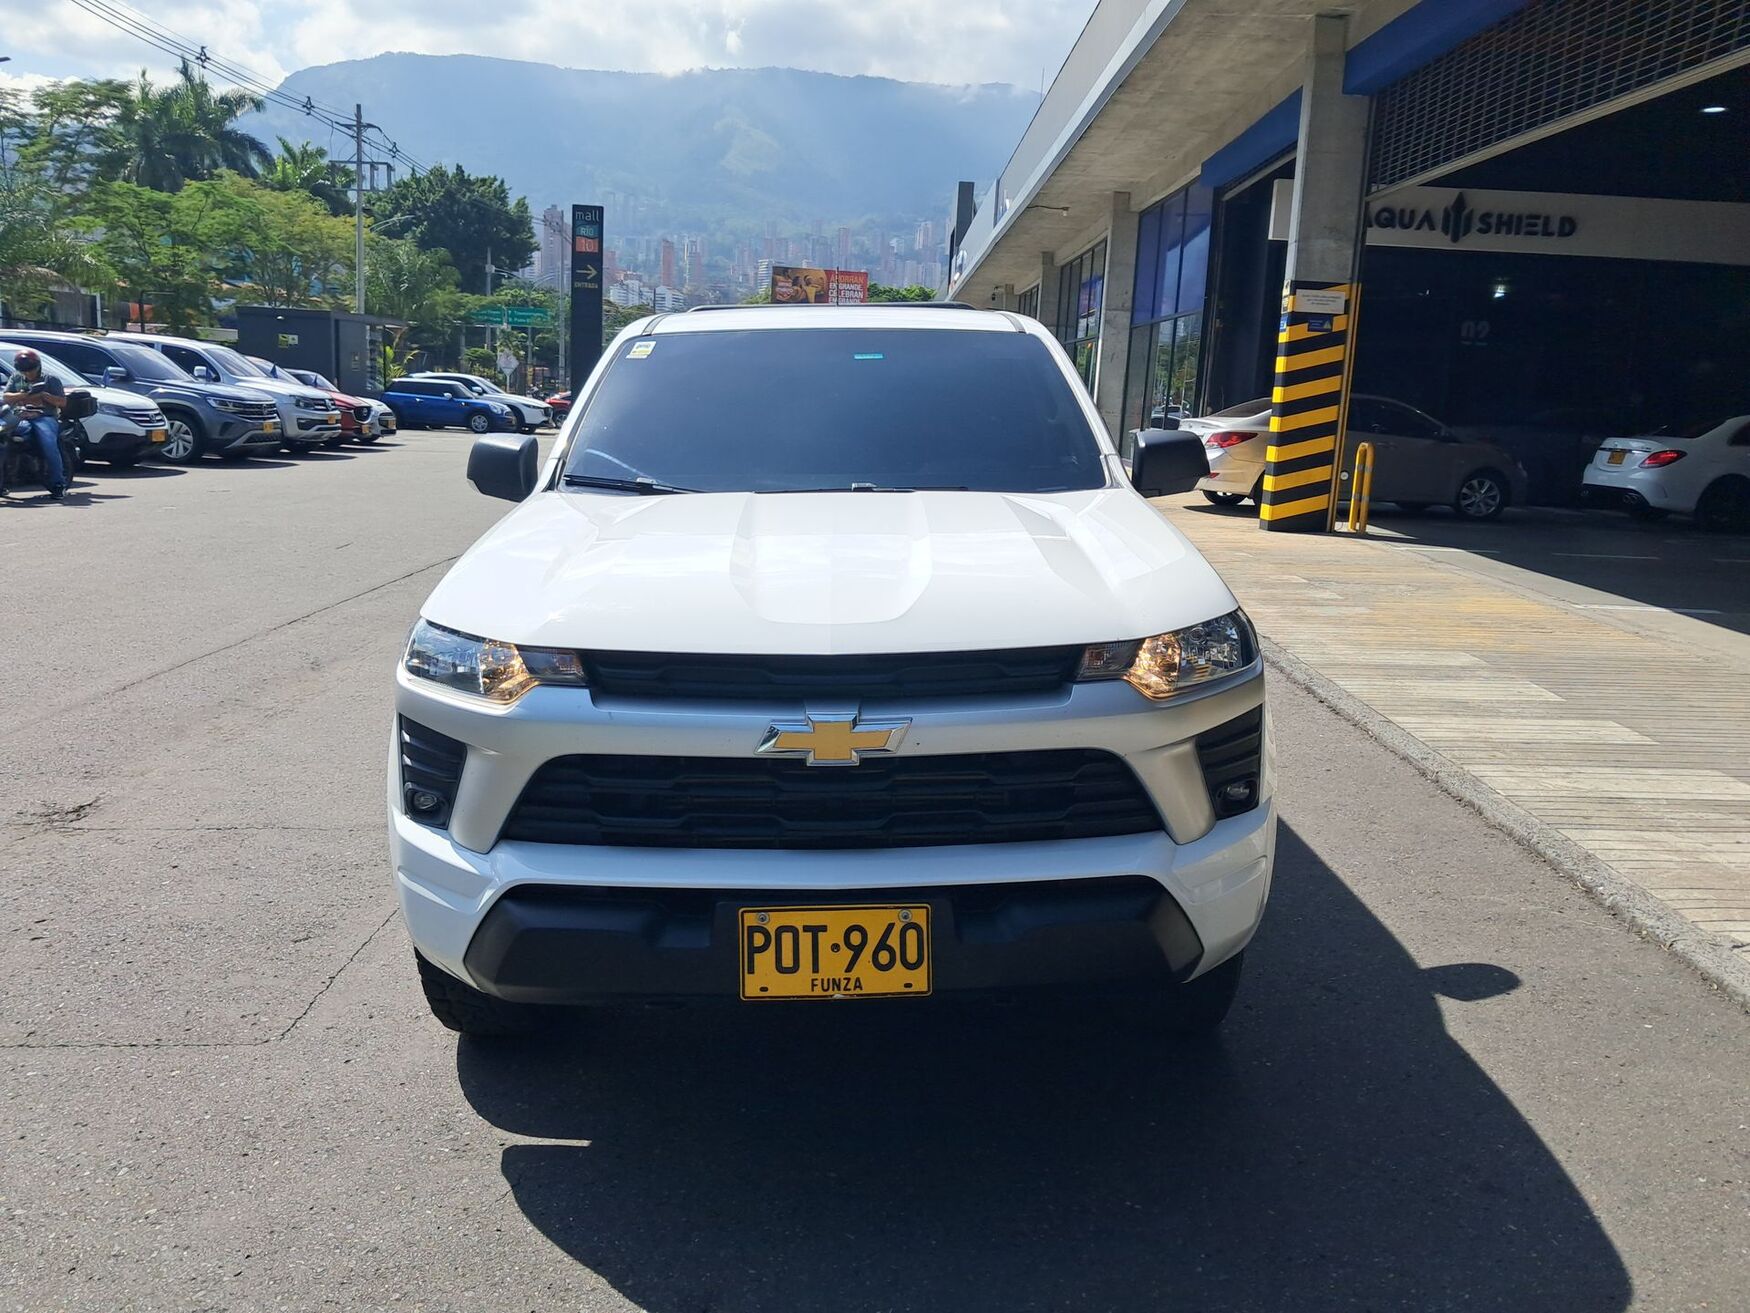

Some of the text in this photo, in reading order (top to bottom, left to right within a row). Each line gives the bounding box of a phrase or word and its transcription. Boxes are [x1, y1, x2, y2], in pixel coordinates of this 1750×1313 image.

[575, 209, 600, 222] mall
[1476, 211, 1577, 237] SHIELD
[828, 289, 864, 299] CELEBRAN
[811, 977, 863, 992] FUNZA
